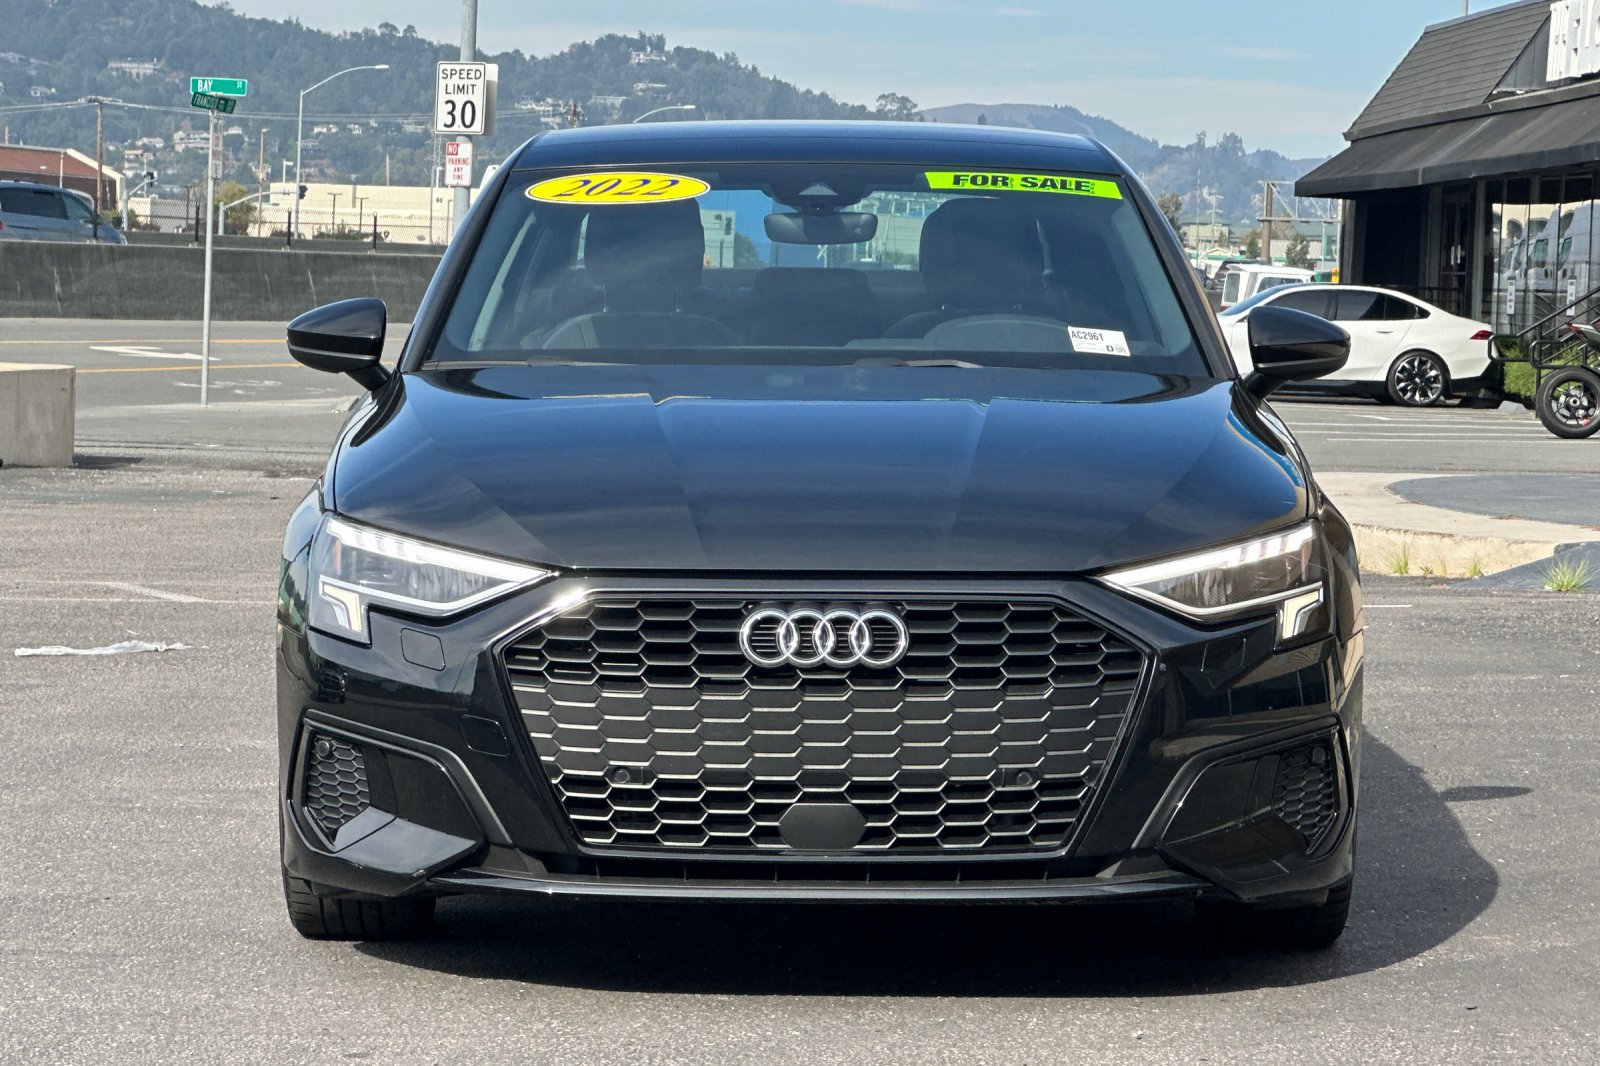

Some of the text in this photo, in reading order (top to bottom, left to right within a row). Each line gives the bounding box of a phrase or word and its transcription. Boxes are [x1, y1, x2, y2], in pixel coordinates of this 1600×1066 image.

[441, 68, 482, 80] SPEED
[197, 79, 213, 92] BAY
[445, 83, 477, 95] LIMIT
[443, 99, 476, 129] 30
[448, 143, 458, 155] NO
[448, 157, 470, 166] PARKING
[551, 179, 680, 197] 2022
[952, 174, 1094, 193] FOR SALE
[1071, 330, 1104, 341] AC2961
